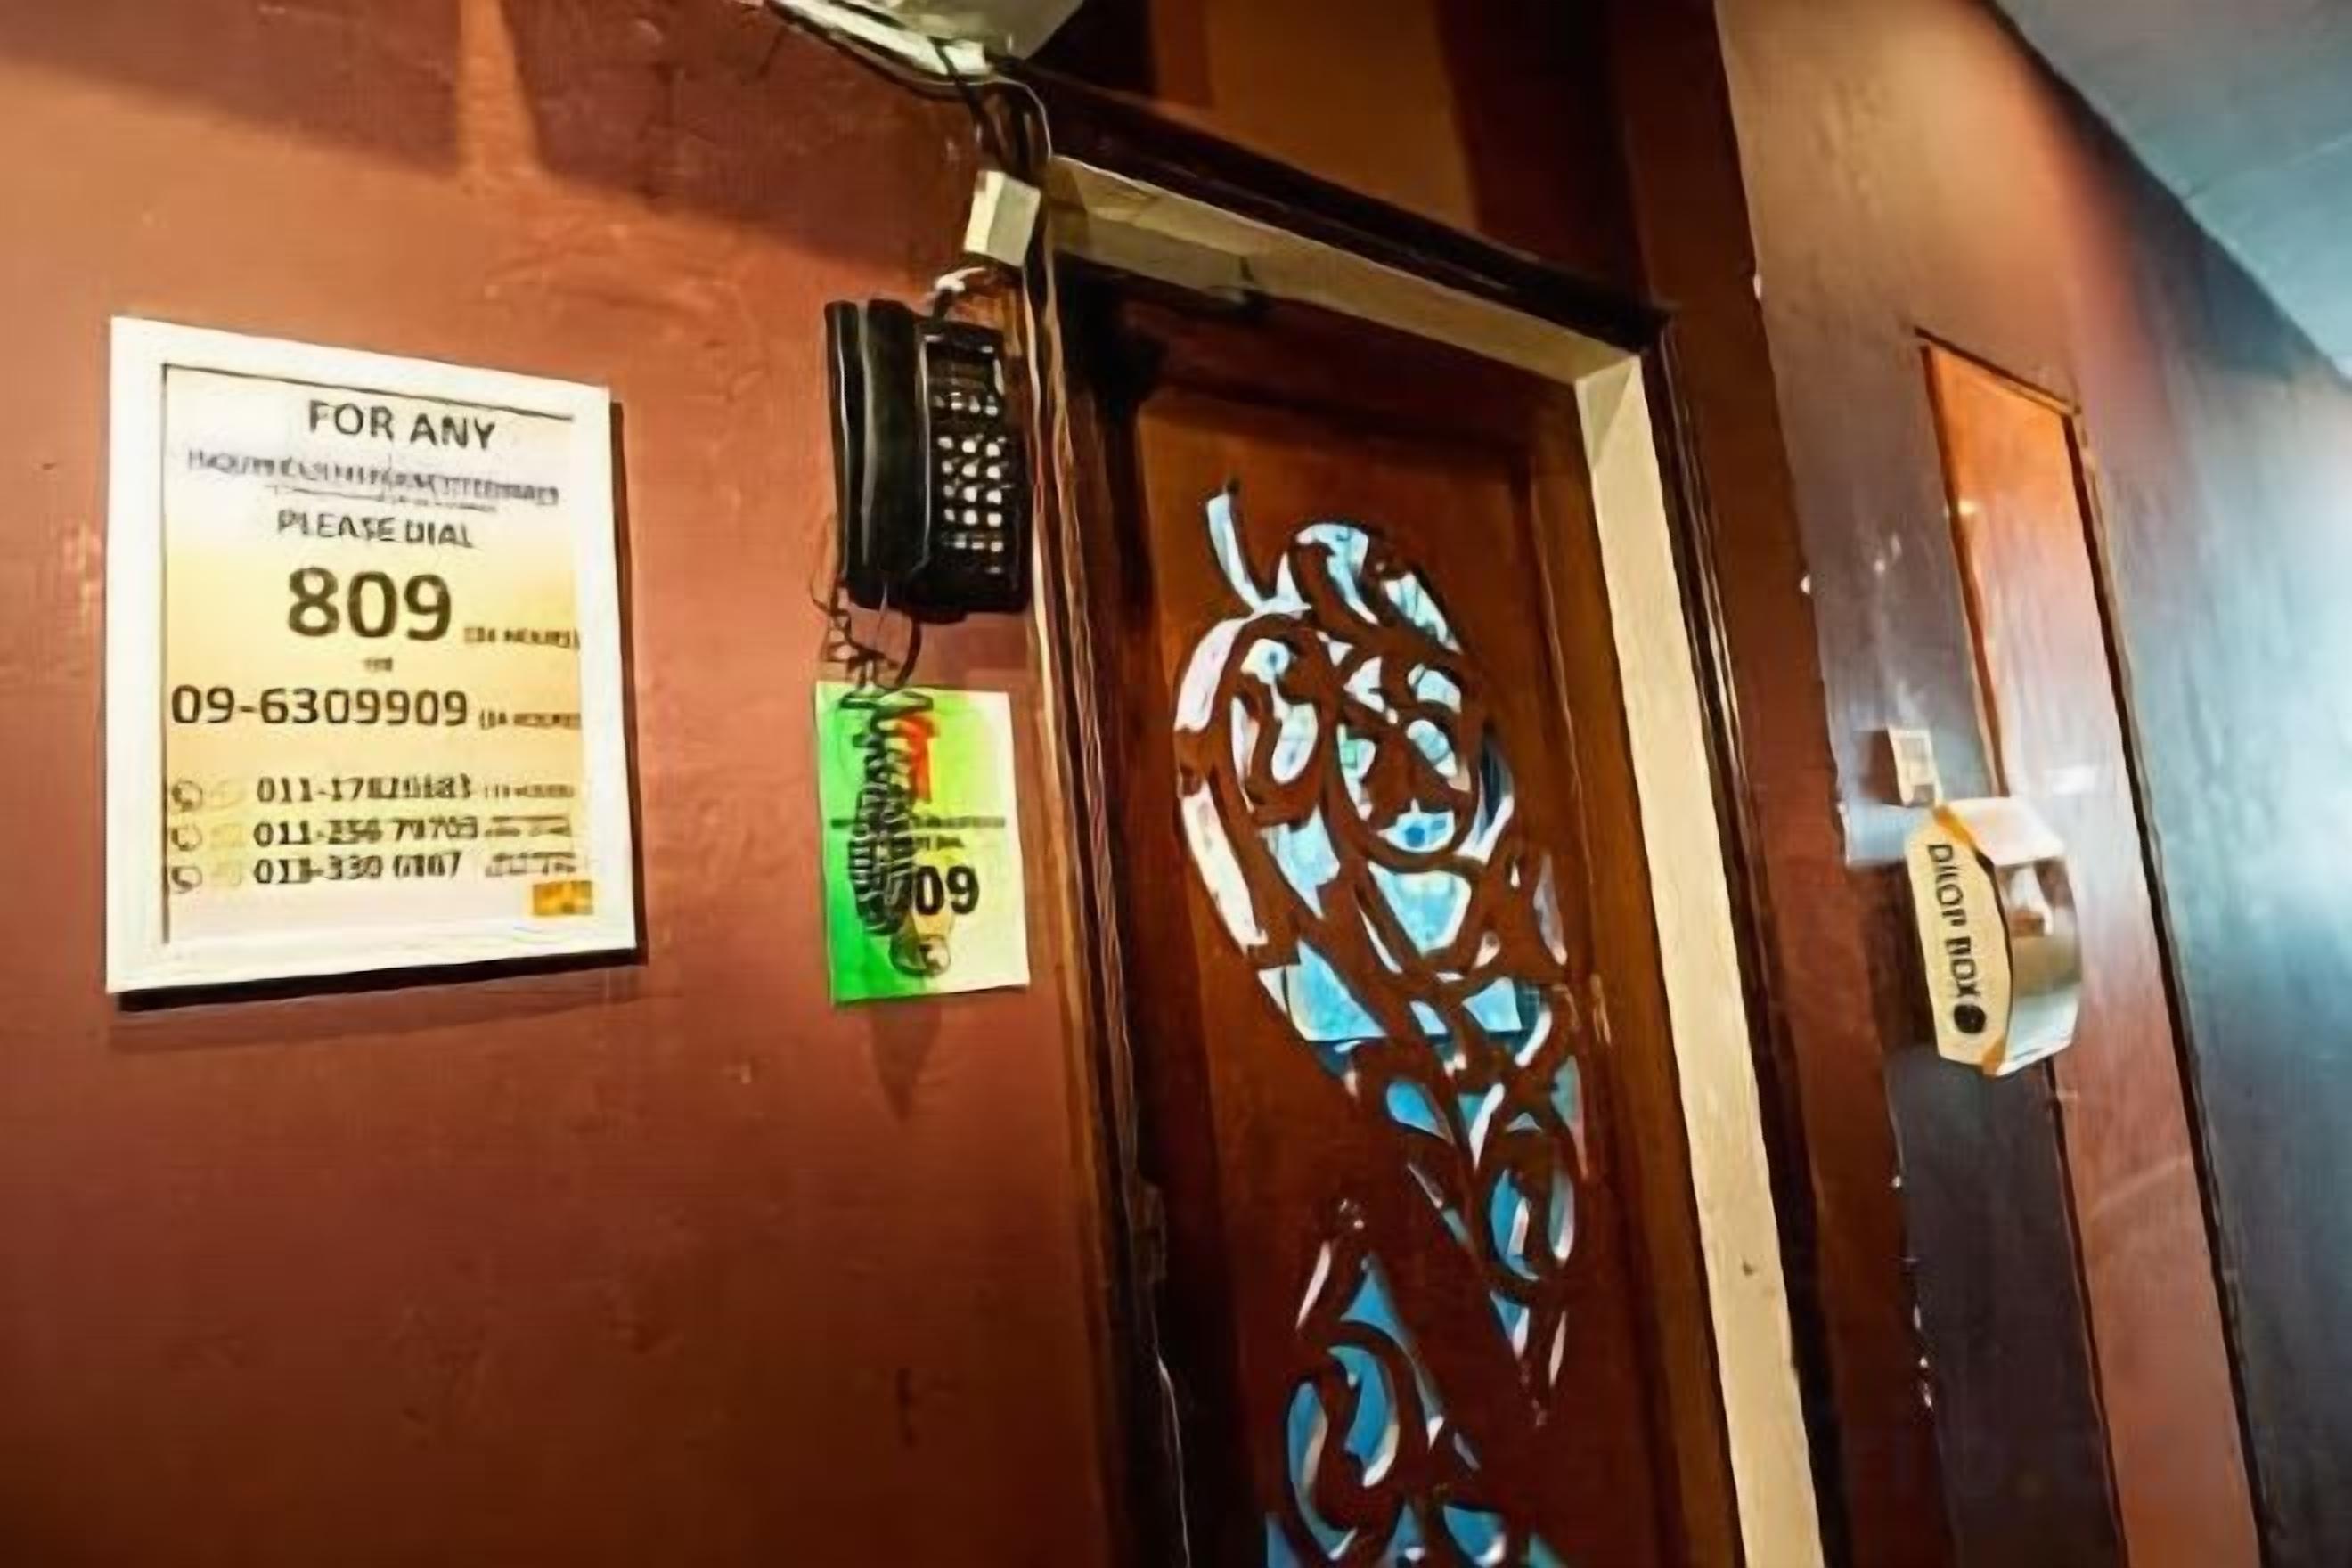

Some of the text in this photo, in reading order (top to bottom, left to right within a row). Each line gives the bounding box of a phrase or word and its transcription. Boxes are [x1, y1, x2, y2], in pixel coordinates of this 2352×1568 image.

[309, 398, 497, 451] FOR ANY
[287, 566, 453, 641] 809
[170, 683, 469, 726] 09-6309909
[914, 864, 980, 916] 09
